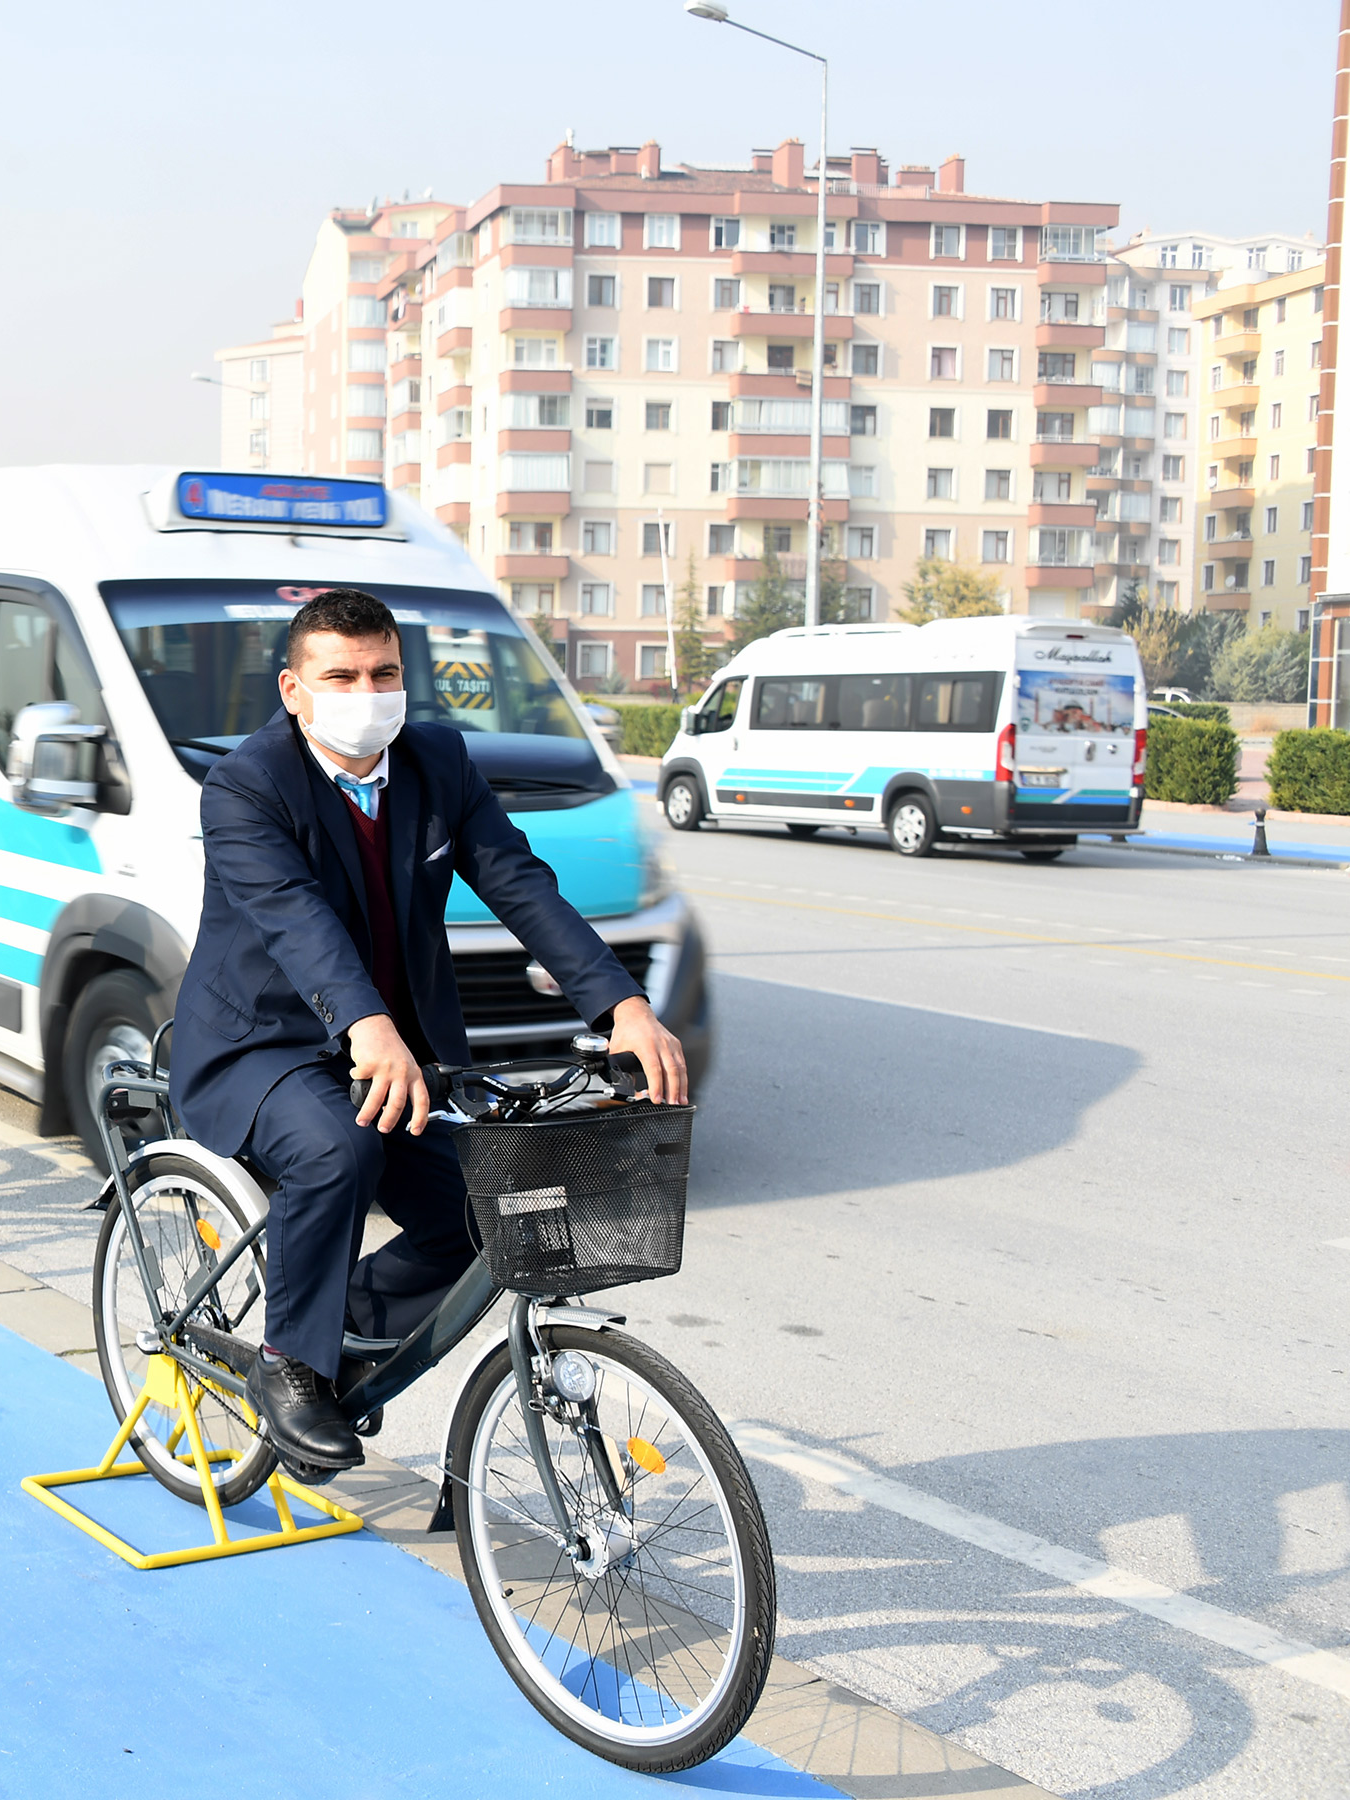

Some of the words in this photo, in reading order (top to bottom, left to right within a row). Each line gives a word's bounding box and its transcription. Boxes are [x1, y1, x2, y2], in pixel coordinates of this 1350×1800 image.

[207, 488, 289, 517] MERAM
[344, 497, 384, 521] YOL
[456, 679, 490, 694] TAŞITI
